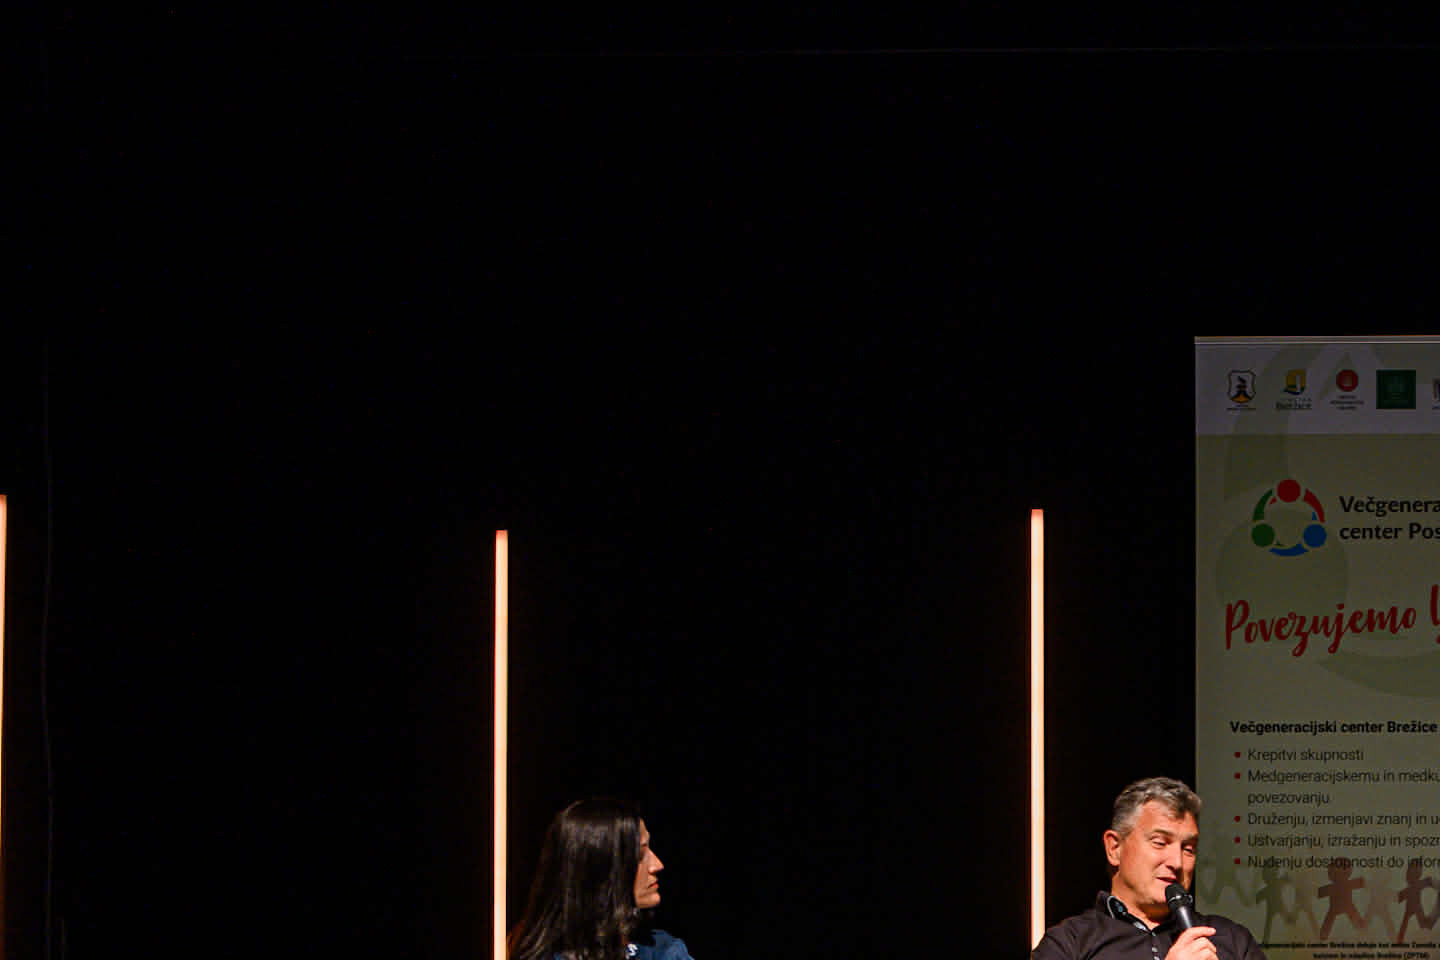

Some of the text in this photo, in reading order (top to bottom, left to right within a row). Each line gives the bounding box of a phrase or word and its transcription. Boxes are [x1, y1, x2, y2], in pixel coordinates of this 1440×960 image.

[1340, 524, 1402, 540] center
[1225, 599, 1418, 657] Povezujemo
[1230, 720, 1337, 736] Večgeneracijski
[1341, 722, 1384, 734] center
[1387, 720, 1438, 734] Brežice
[1247, 748, 1364, 764] Krepitvi skupnosti
[1247, 769, 1380, 785] Medgeneracijskemu
[1383, 770, 1396, 783] in
[1247, 792, 1330, 807] povezovanju
[1247, 811, 1308, 827] Druženju,
[1312, 812, 1373, 827] izmenjavi
[1376, 812, 1413, 827] znanj
[1416, 812, 1428, 825] in
[1247, 834, 1325, 849] Ustvarjanju,
[1328, 833, 1387, 849] izražanju
[1390, 834, 1402, 847] in
[1247, 855, 1303, 870] Nudenju
[1305, 855, 1384, 871] dostopnosti
[1387, 855, 1405, 869] do
